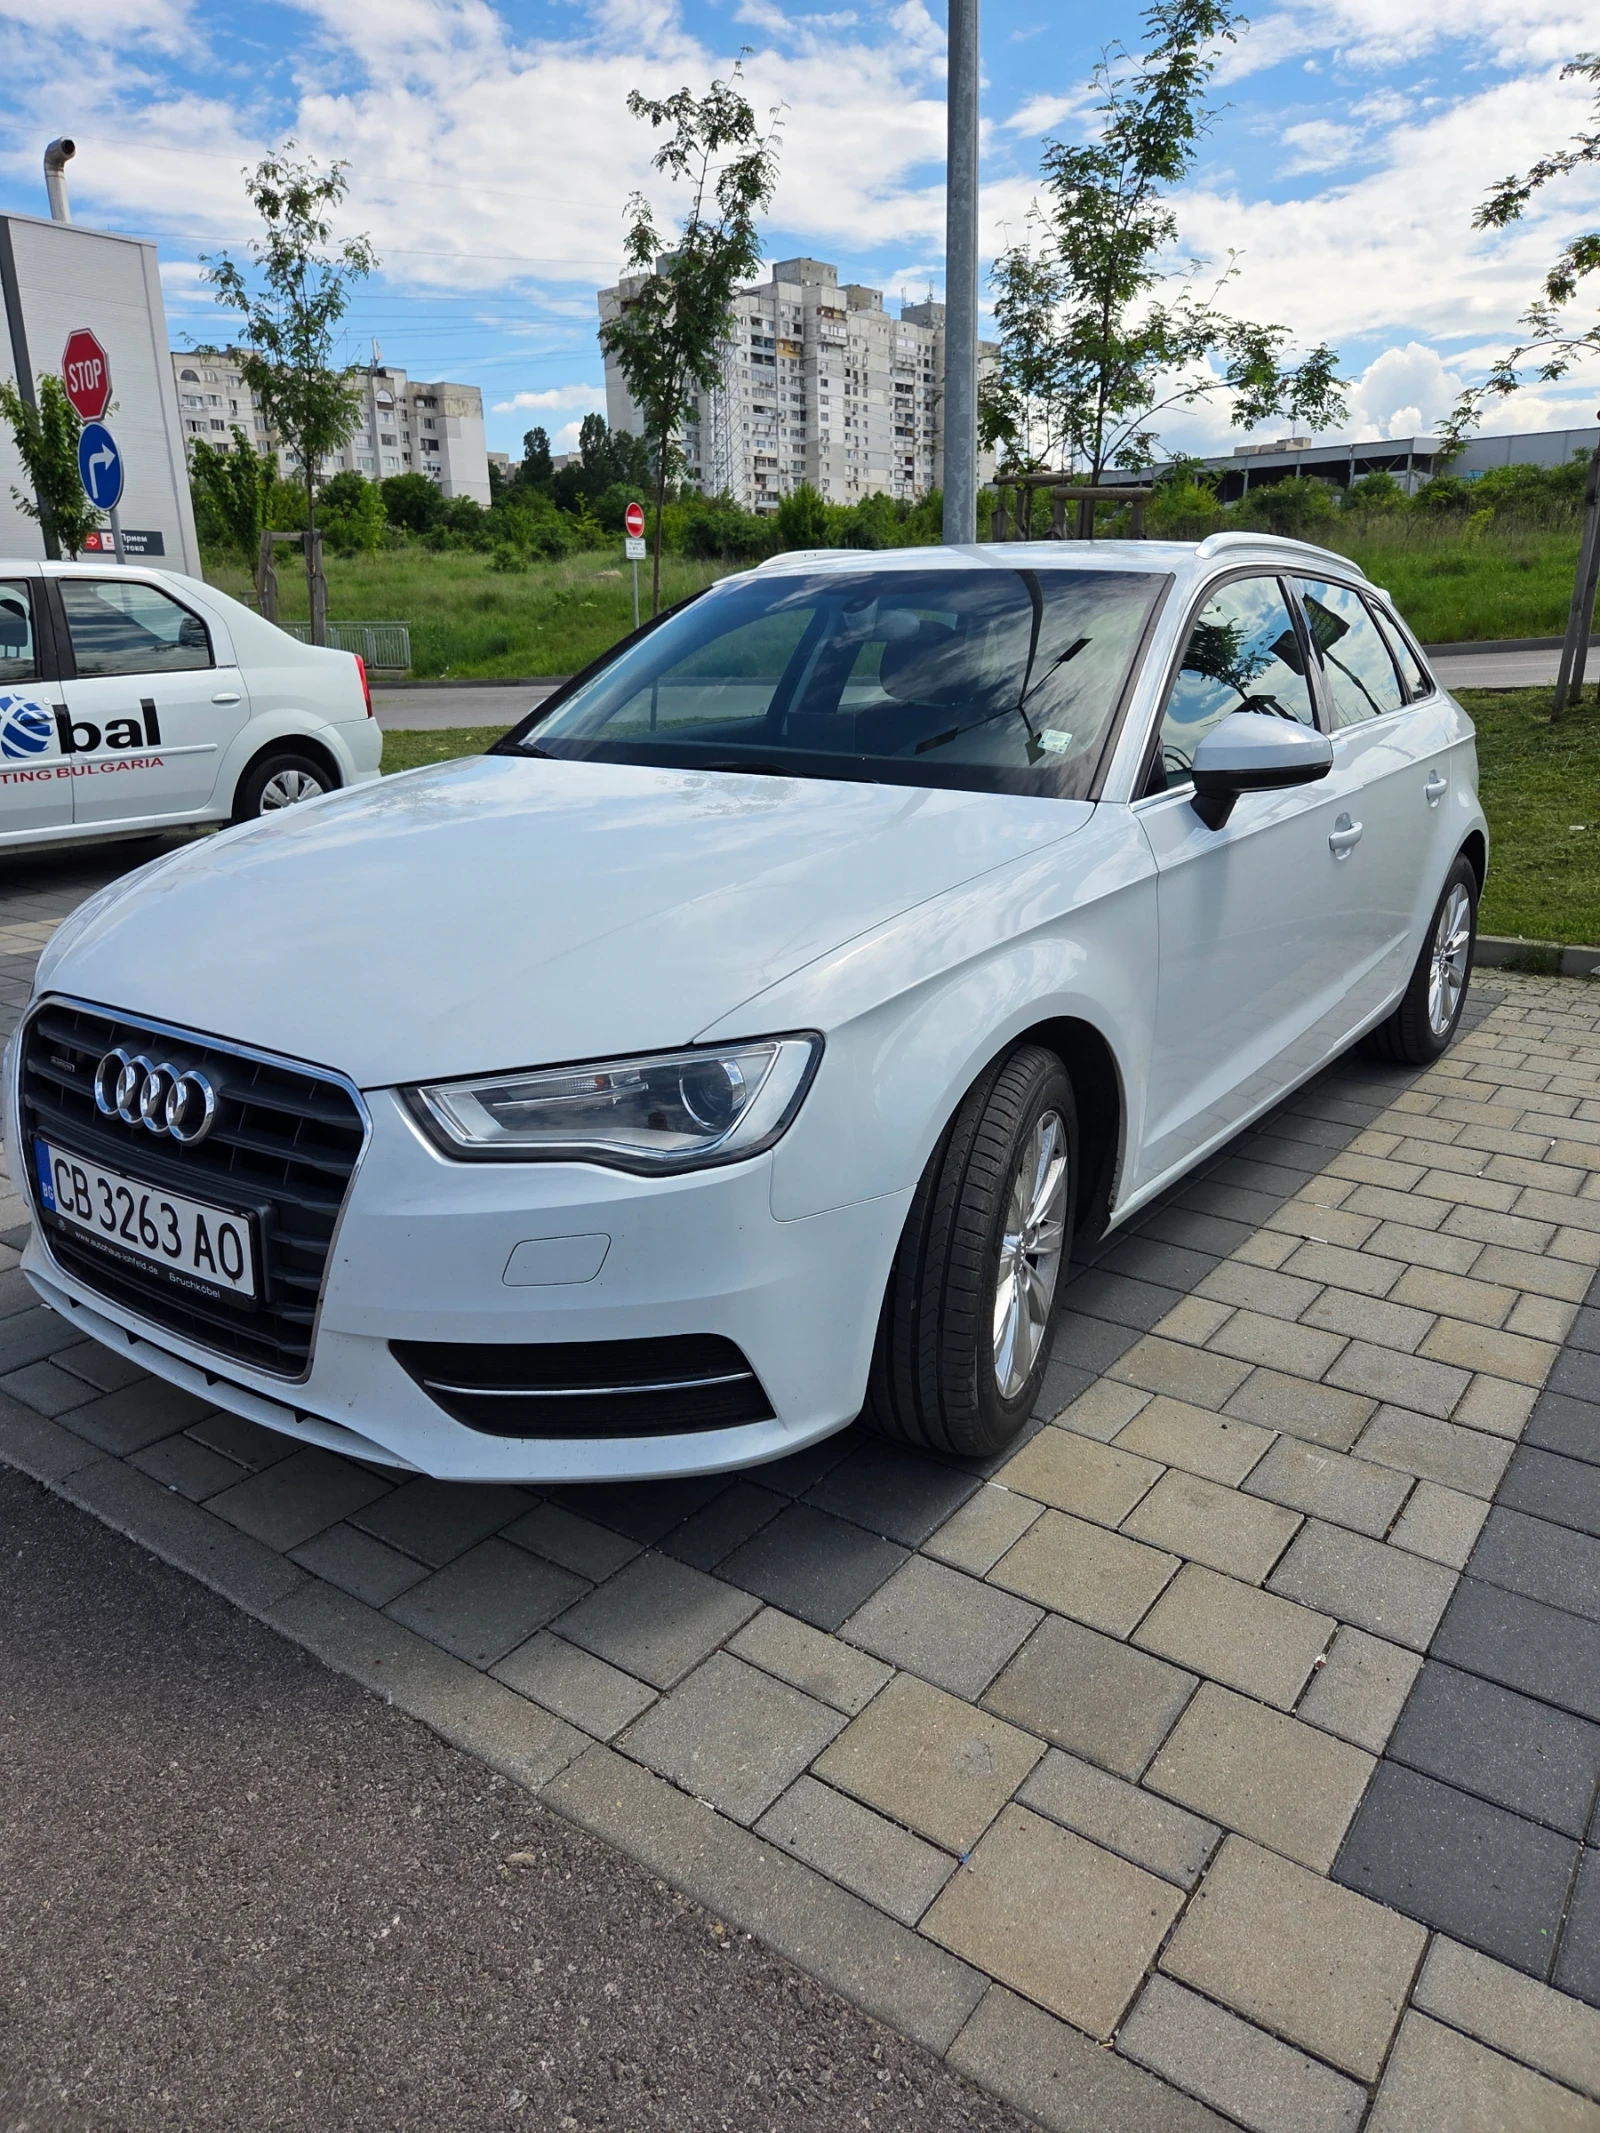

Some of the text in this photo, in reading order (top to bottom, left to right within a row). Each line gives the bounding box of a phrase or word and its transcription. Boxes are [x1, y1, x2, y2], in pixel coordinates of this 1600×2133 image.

[68, 359, 102, 393] STOP
[52, 698, 161, 754] bal
[56, 757, 164, 779] BULGARIA
[42, 1182, 54, 1200] BG
[54, 1158, 244, 1280] CB 3263 AO
[168, 1272, 221, 1298] Bruchköbel
